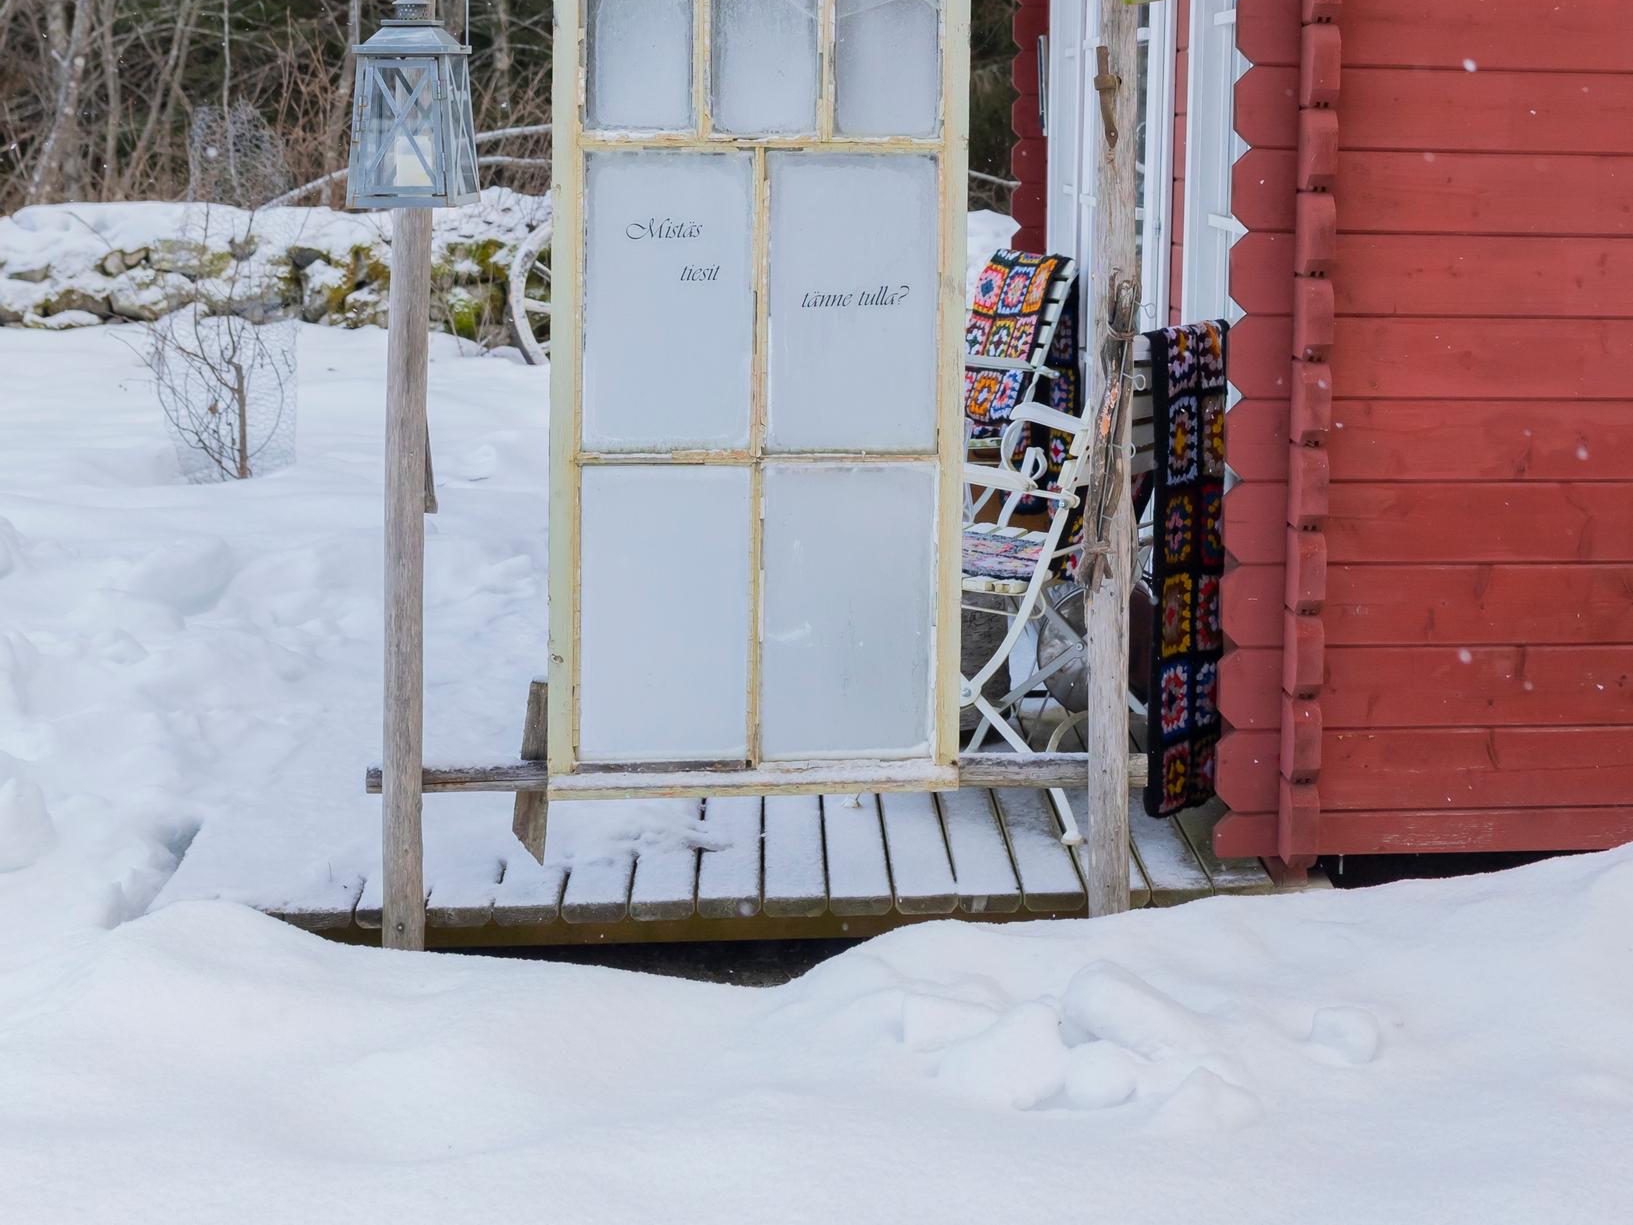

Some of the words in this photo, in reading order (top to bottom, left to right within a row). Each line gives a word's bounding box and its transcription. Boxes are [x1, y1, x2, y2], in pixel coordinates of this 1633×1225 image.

[625, 217, 703, 240] Mistäs
[680, 264, 720, 281] tiesit
[801, 291, 853, 308] tänne
[858, 285, 910, 306] tulla?
